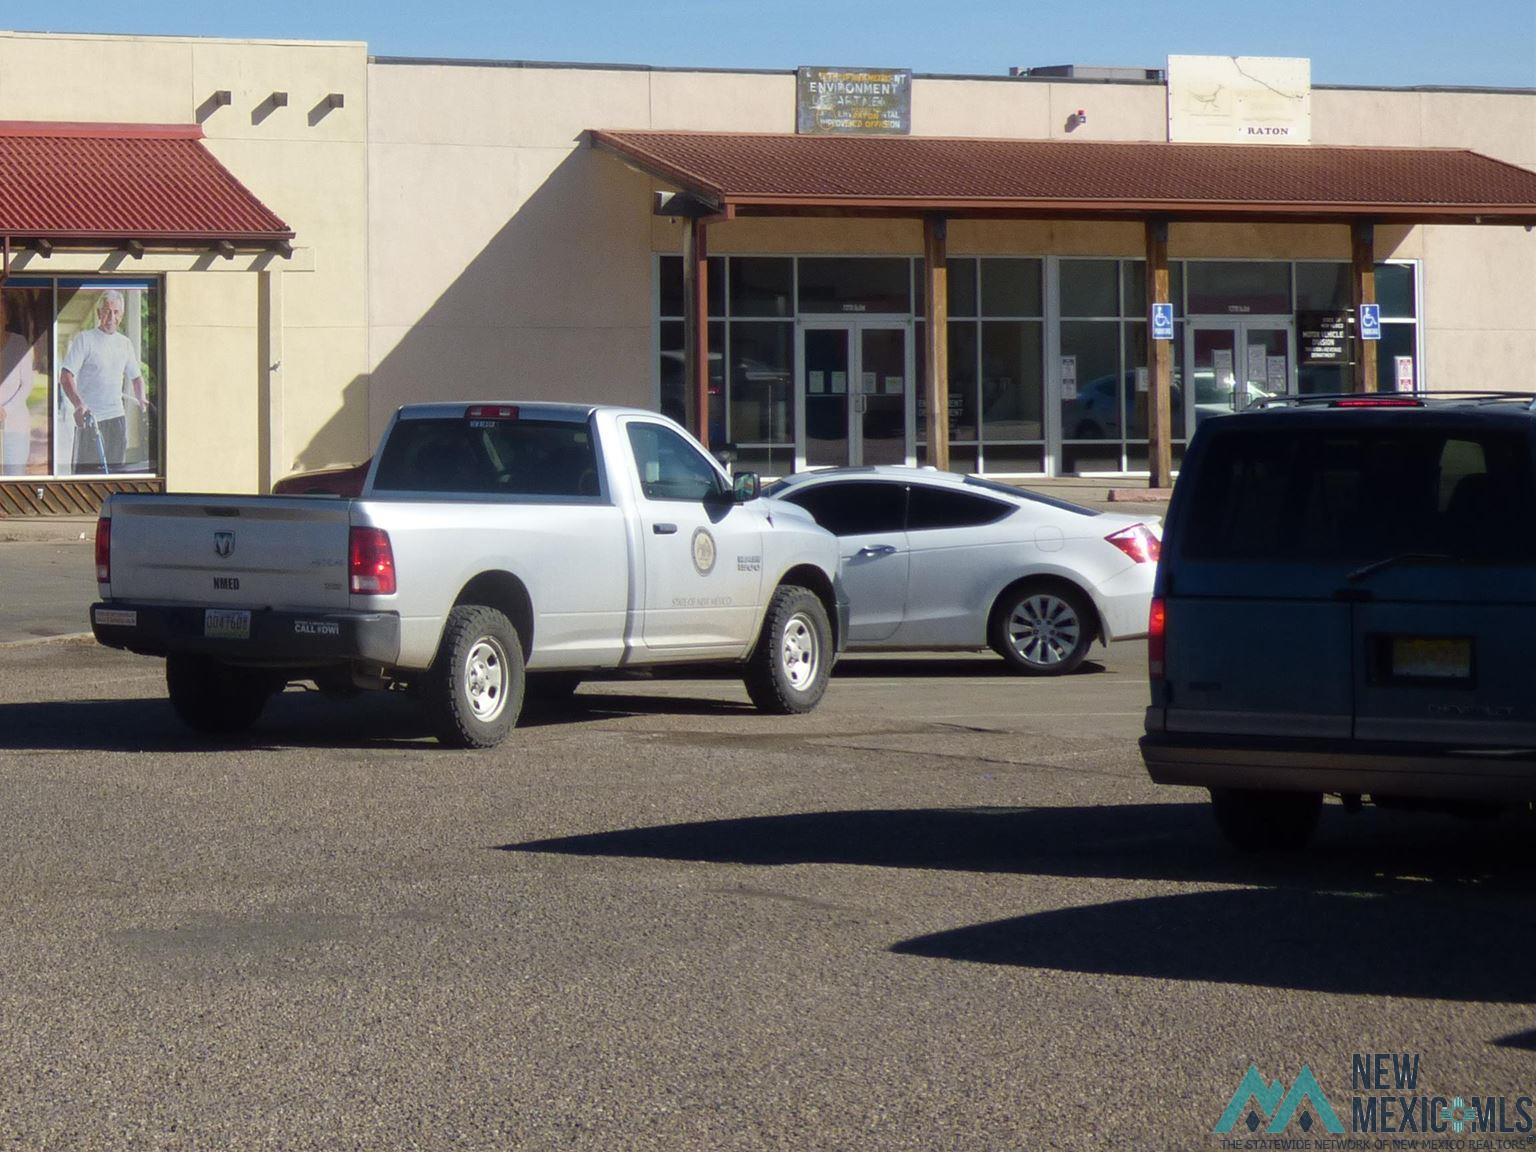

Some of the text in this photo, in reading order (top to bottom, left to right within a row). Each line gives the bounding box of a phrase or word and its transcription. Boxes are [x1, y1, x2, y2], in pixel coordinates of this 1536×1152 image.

[809, 82, 898, 95] ENVIRONMENT
[1247, 127, 1289, 135] RATON
[213, 576, 240, 590] NMED
[294, 624, 316, 633] CALL
